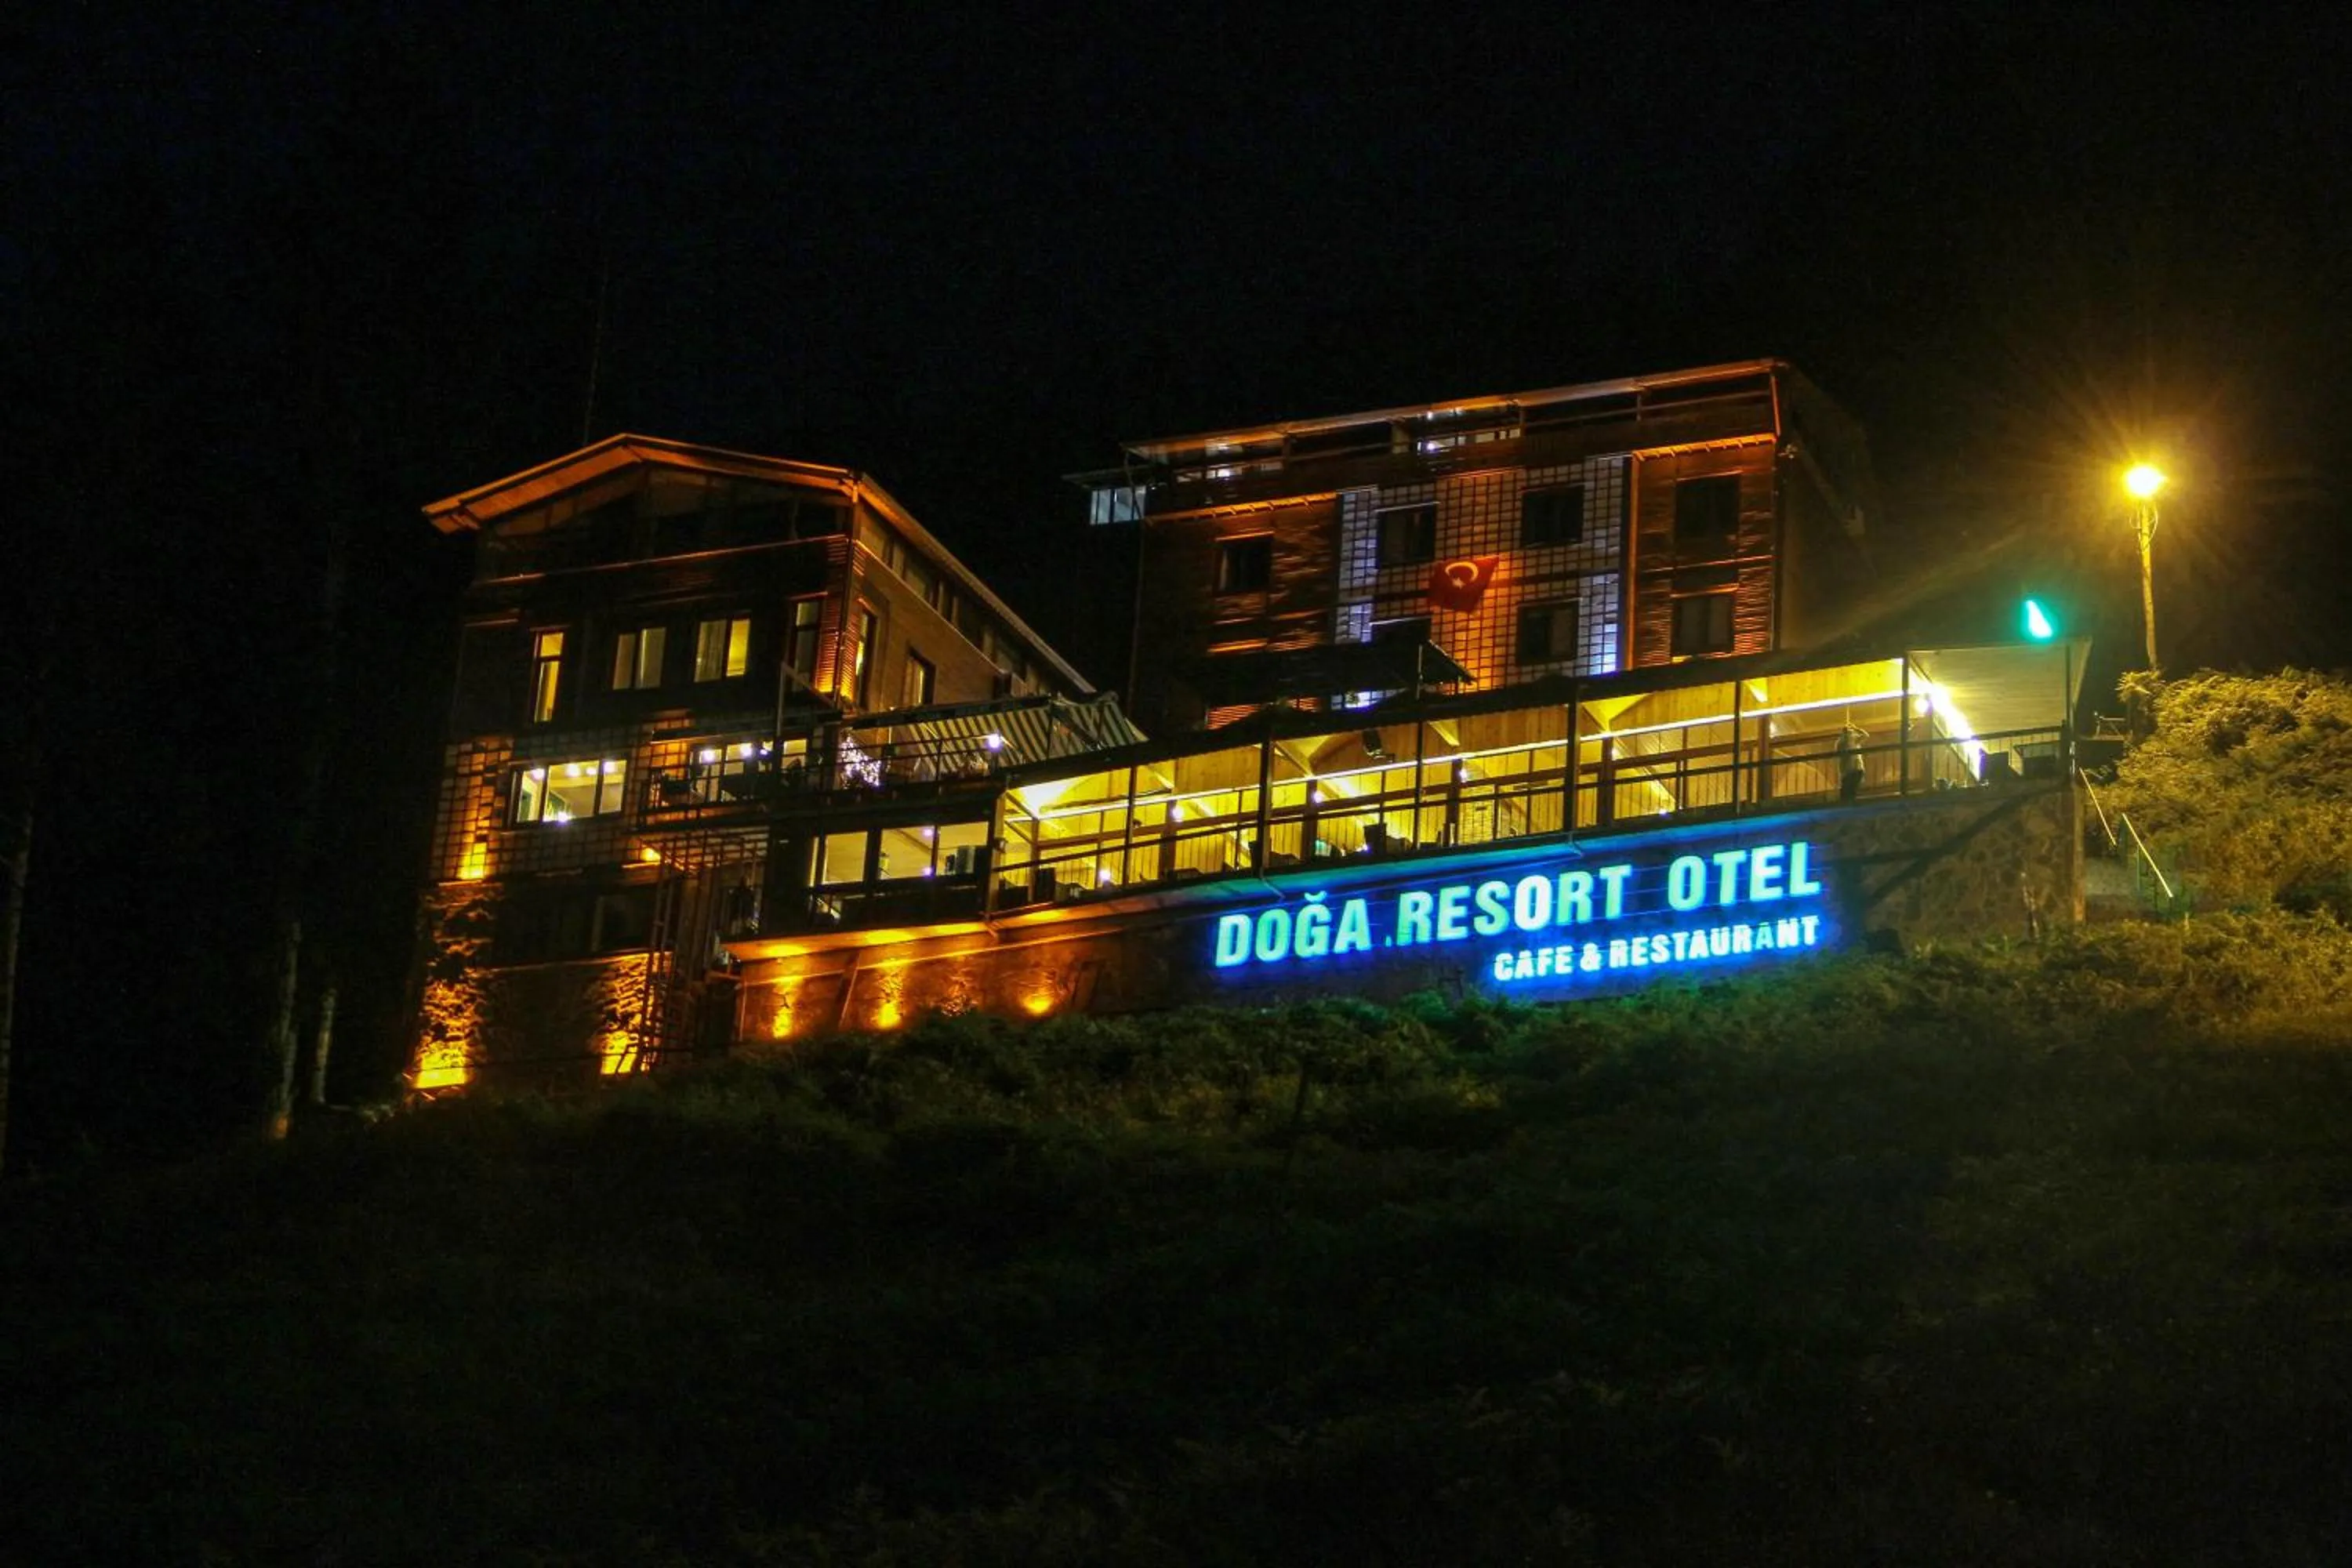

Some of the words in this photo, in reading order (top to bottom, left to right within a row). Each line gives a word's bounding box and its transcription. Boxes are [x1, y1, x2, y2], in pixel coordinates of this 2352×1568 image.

[1215, 891, 1372, 967] DOĞA
[1668, 841, 1820, 911] OTEL
[1494, 946, 1573, 982] CAFE
[1580, 942, 1601, 972] &
[1609, 915, 1819, 969] RESTAURANT
